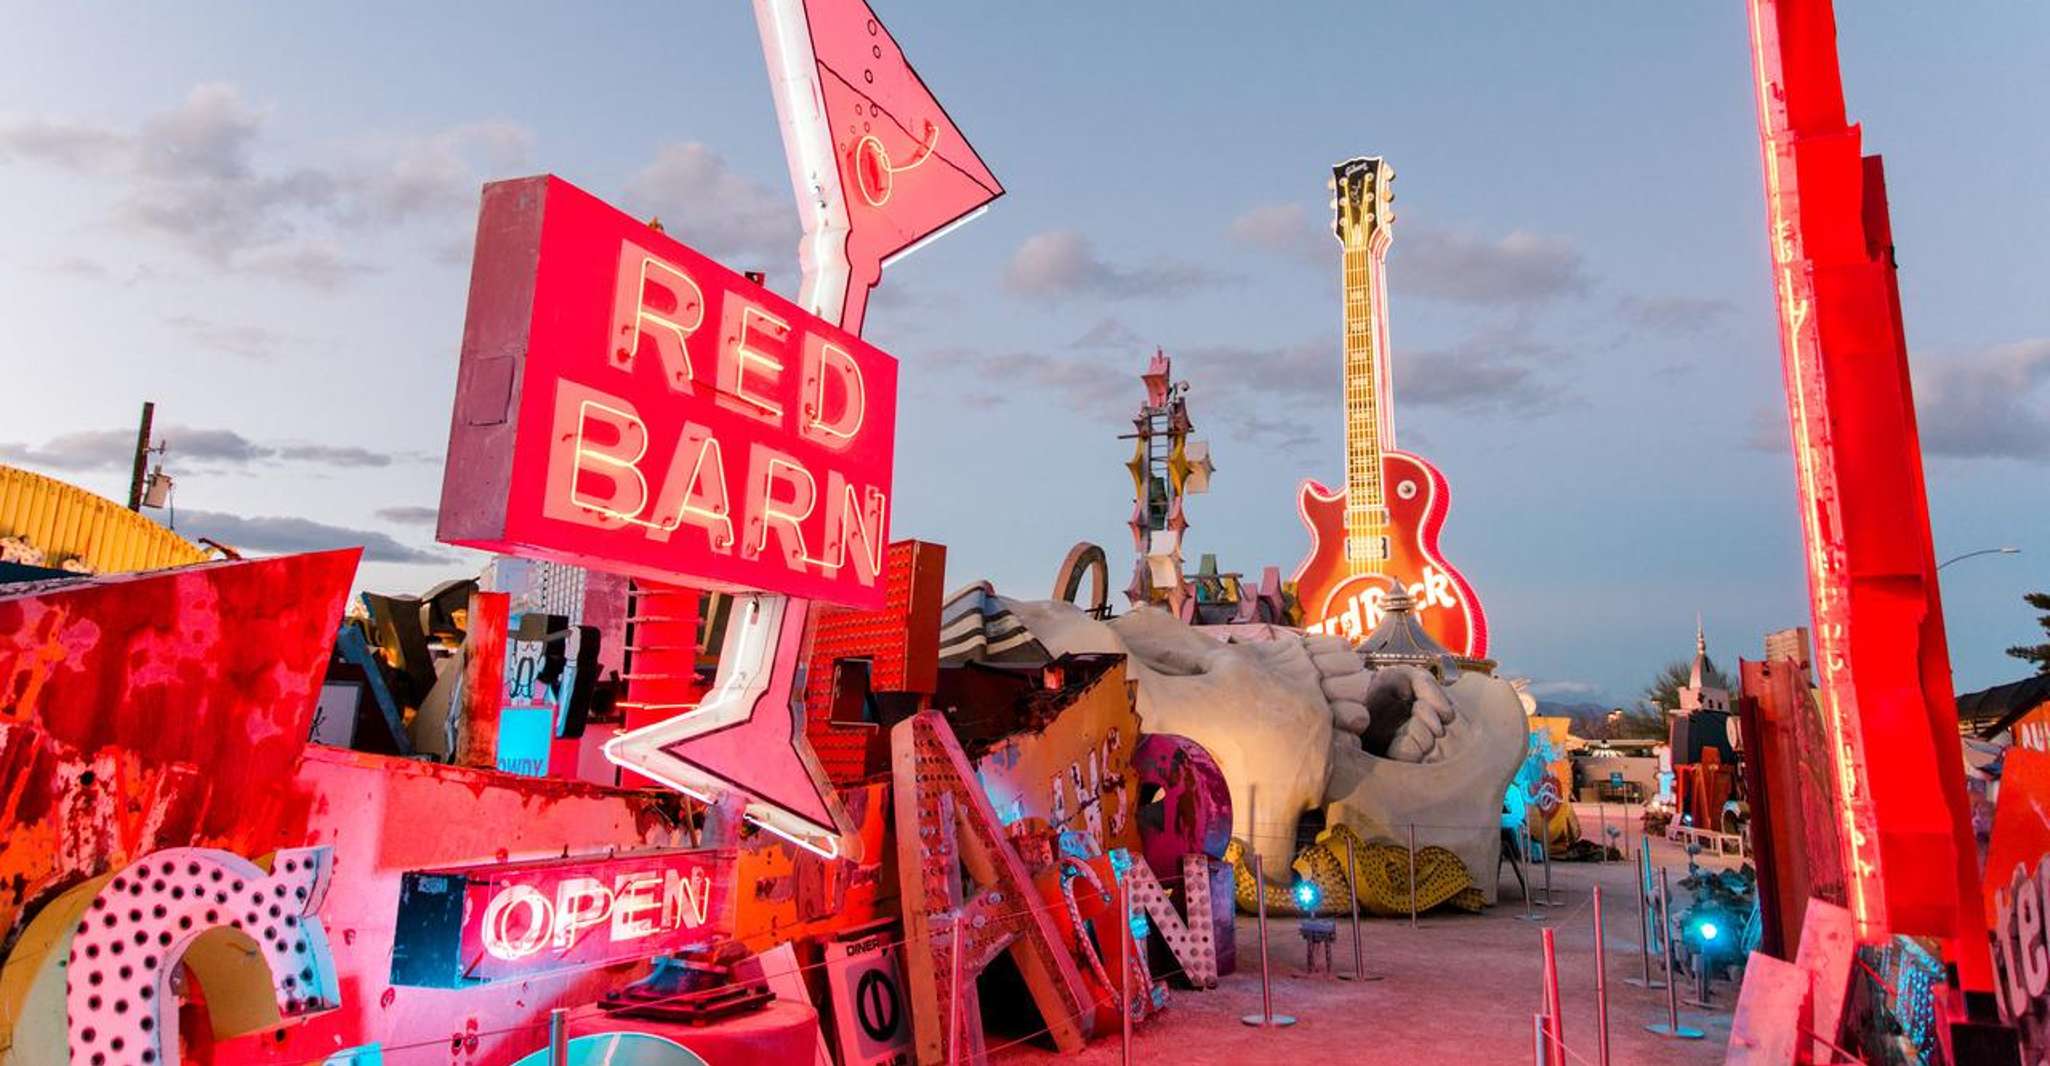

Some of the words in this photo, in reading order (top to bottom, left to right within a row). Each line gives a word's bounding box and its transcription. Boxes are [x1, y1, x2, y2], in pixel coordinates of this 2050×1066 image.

[608, 238, 865, 455] RED
[543, 377, 886, 588] BARN
[481, 866, 710, 960] OPEN
[846, 940, 881, 957] DINER
